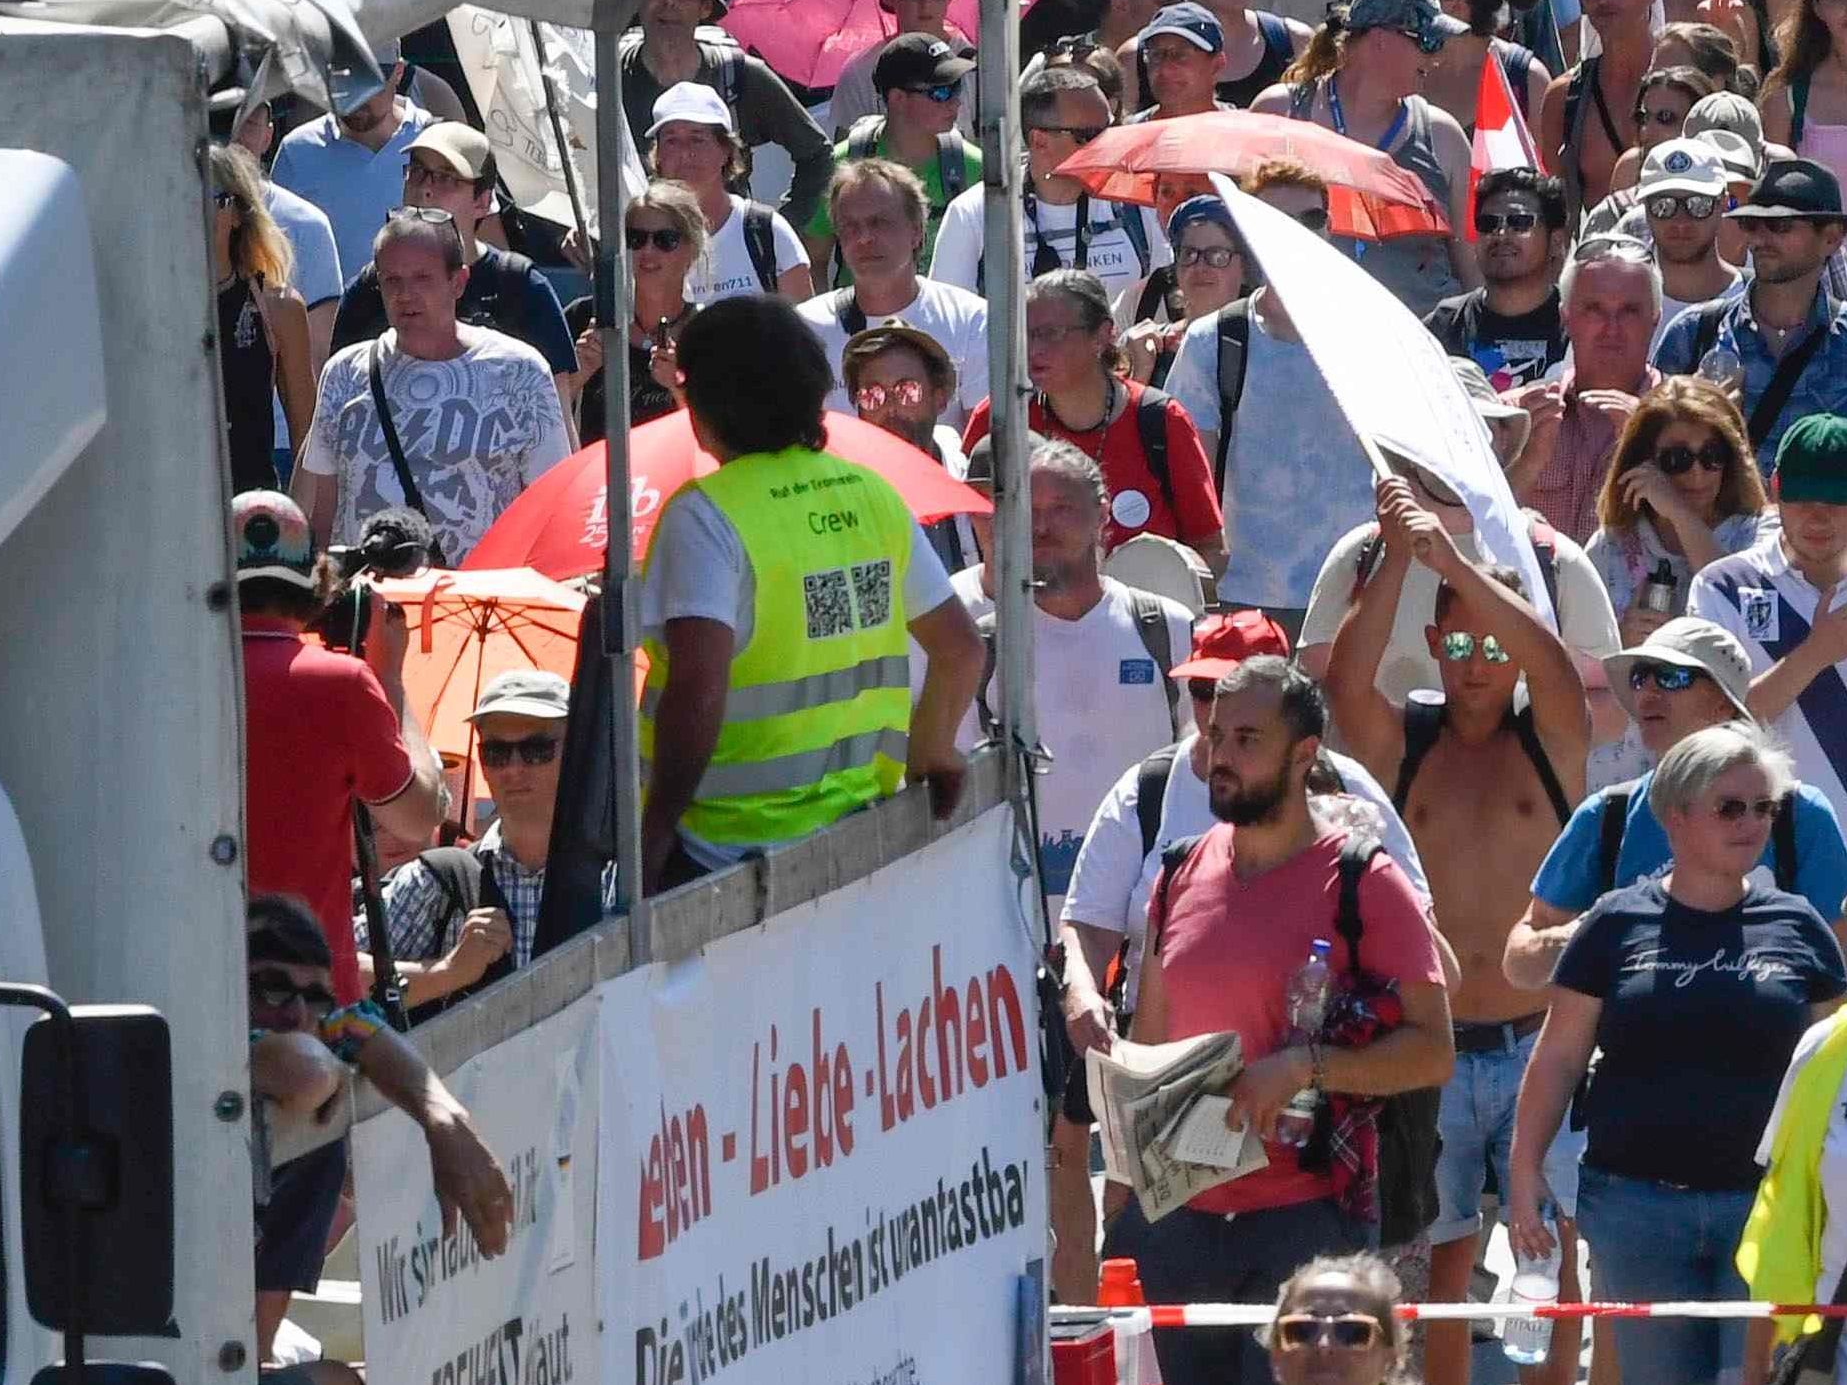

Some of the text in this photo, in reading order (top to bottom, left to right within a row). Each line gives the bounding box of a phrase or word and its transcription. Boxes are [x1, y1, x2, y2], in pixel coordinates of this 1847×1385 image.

[808, 508, 859, 536] Crew
[750, 1007, 855, 1198] Liebe
[875, 943, 1028, 1133] Lachen
